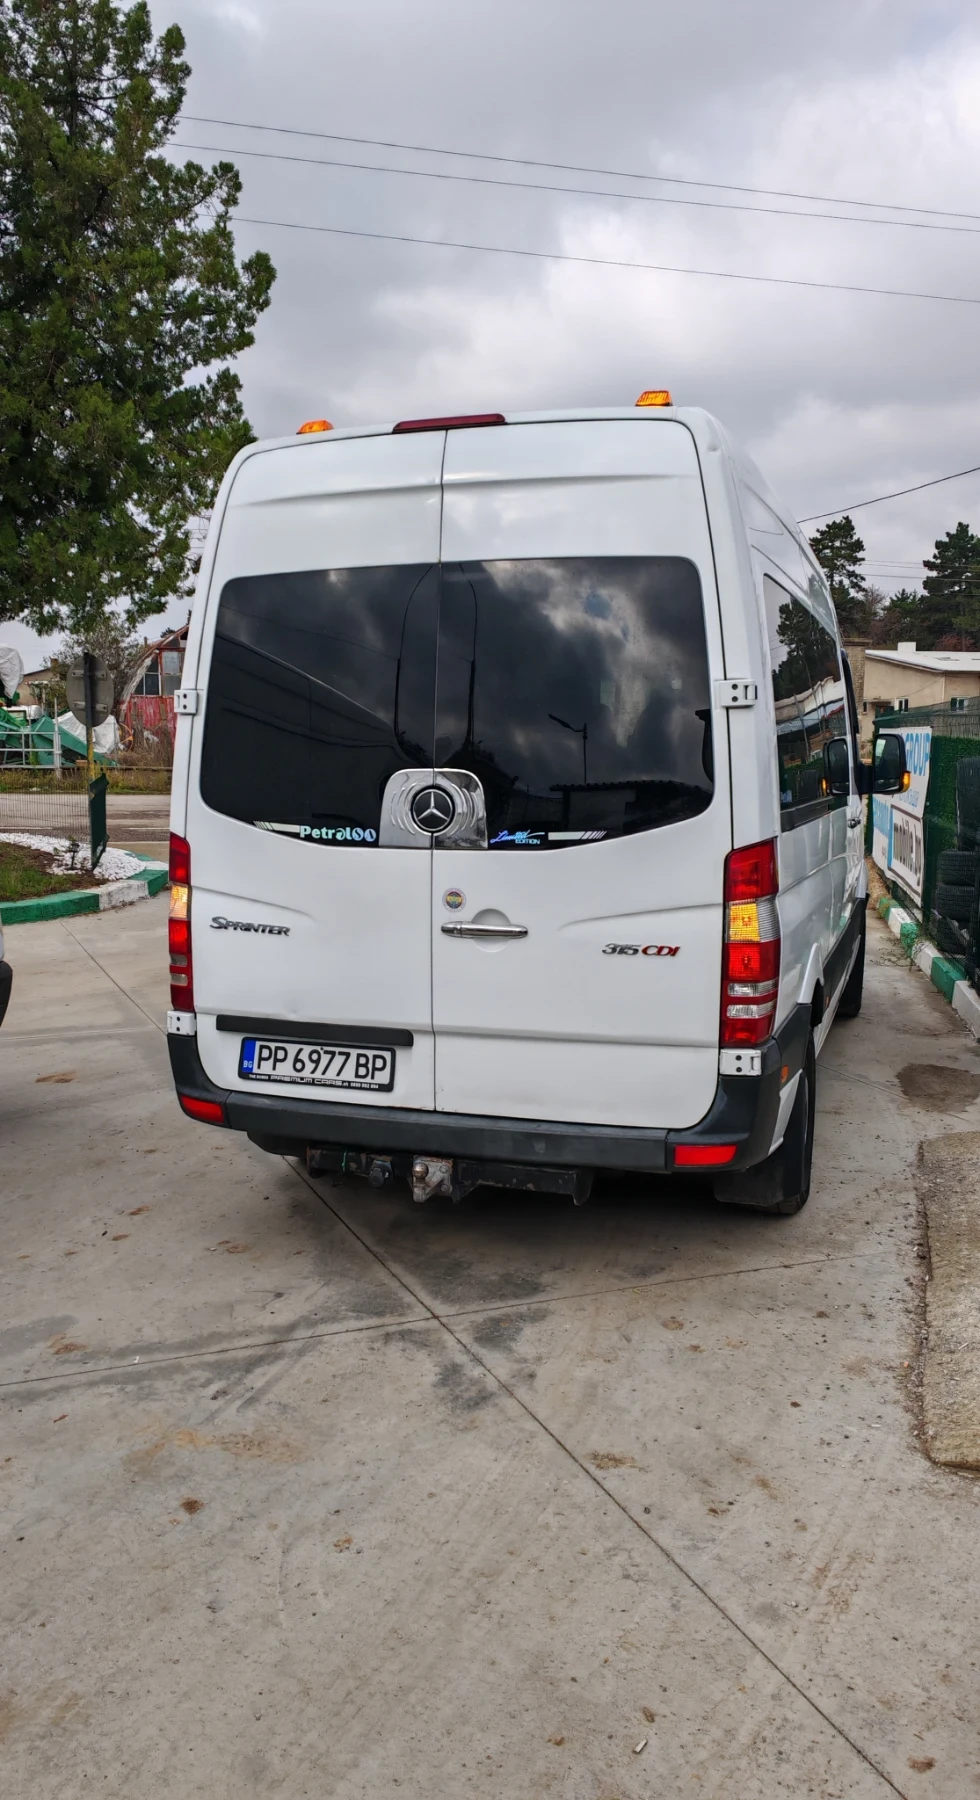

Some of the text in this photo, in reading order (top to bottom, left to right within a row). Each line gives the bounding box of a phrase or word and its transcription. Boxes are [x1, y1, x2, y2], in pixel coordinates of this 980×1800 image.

[601, 943, 681, 957] 315 CDI
[243, 1060, 253, 1069] BG
[257, 1044, 387, 1080] PP 6977 BP
